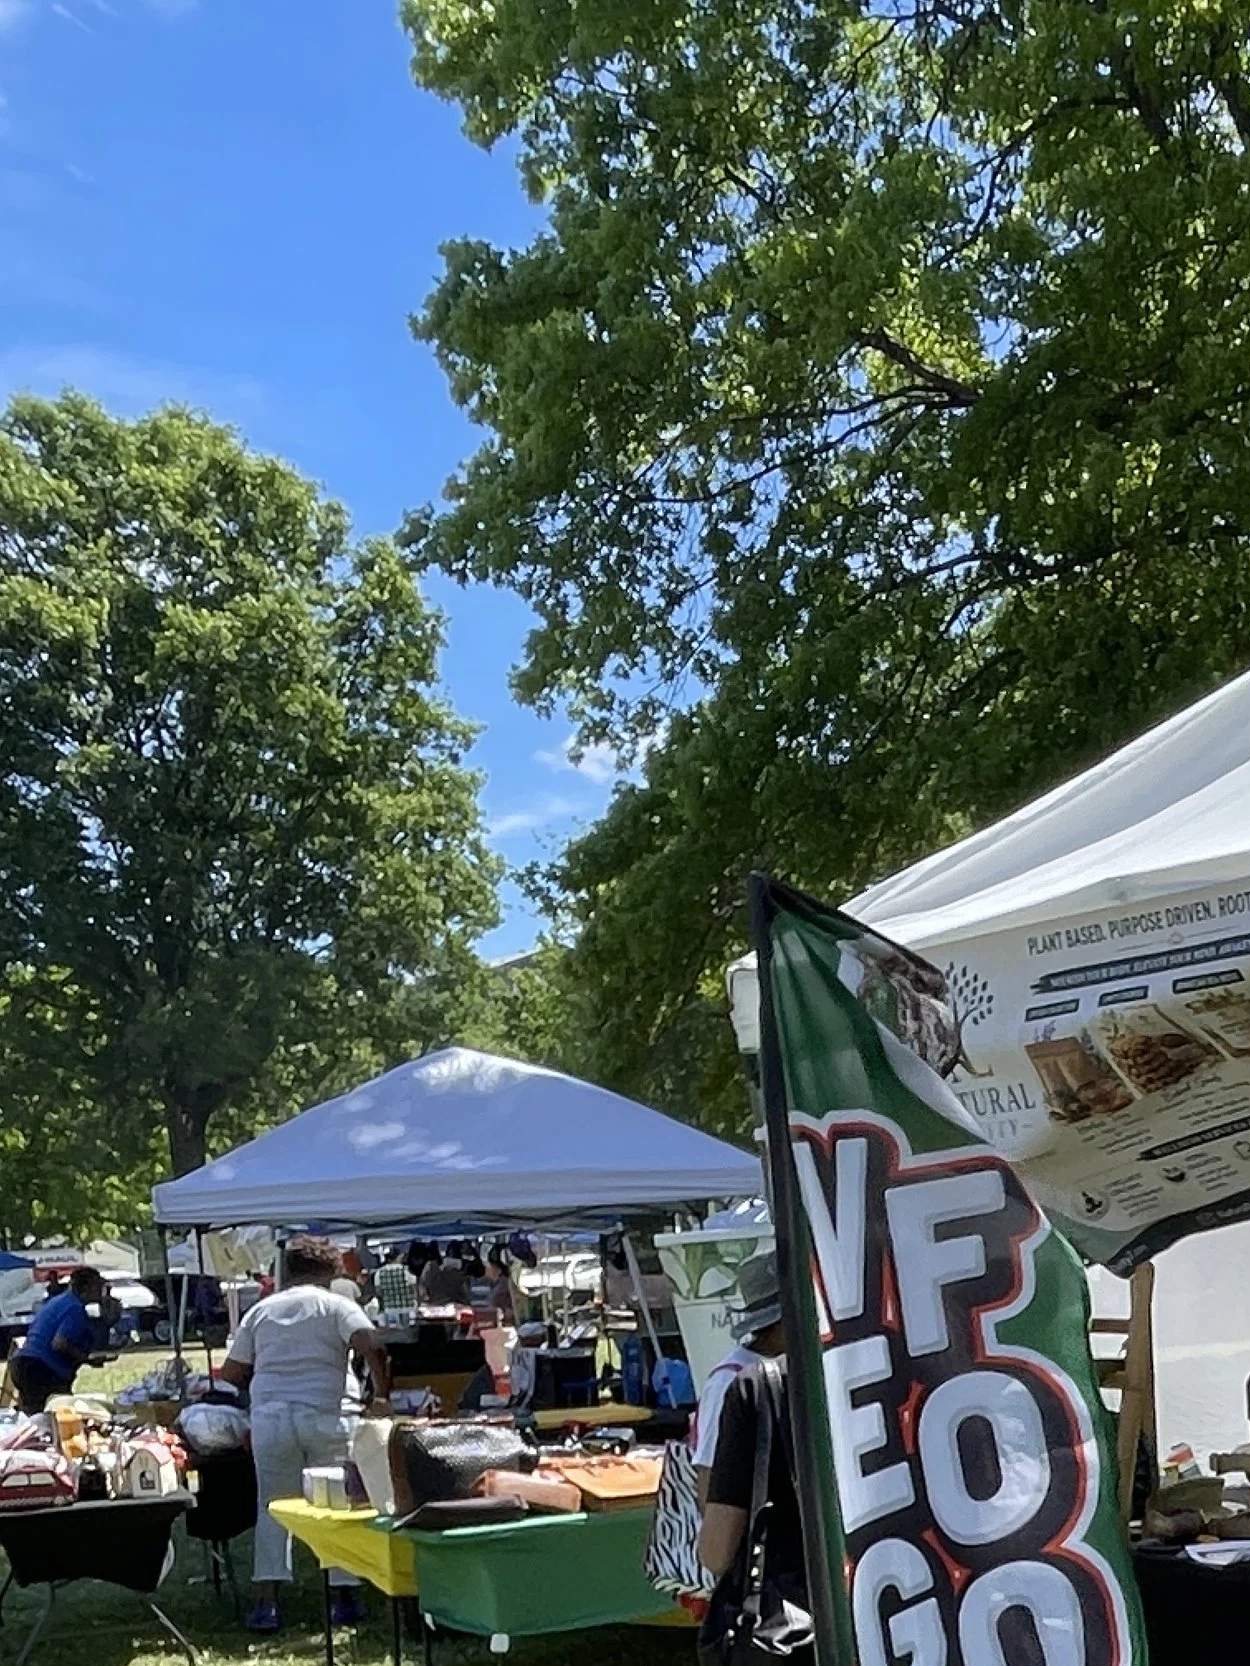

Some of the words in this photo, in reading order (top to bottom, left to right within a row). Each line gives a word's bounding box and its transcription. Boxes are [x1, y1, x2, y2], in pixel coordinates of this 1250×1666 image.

[1027, 931, 1063, 956] PLANT
[1066, 924, 1107, 949] BASED.
[1109, 911, 1164, 939] PURPOSE
[1165, 900, 1216, 928] DRIVEN.
[955, 1083, 1037, 1117] TURAL
